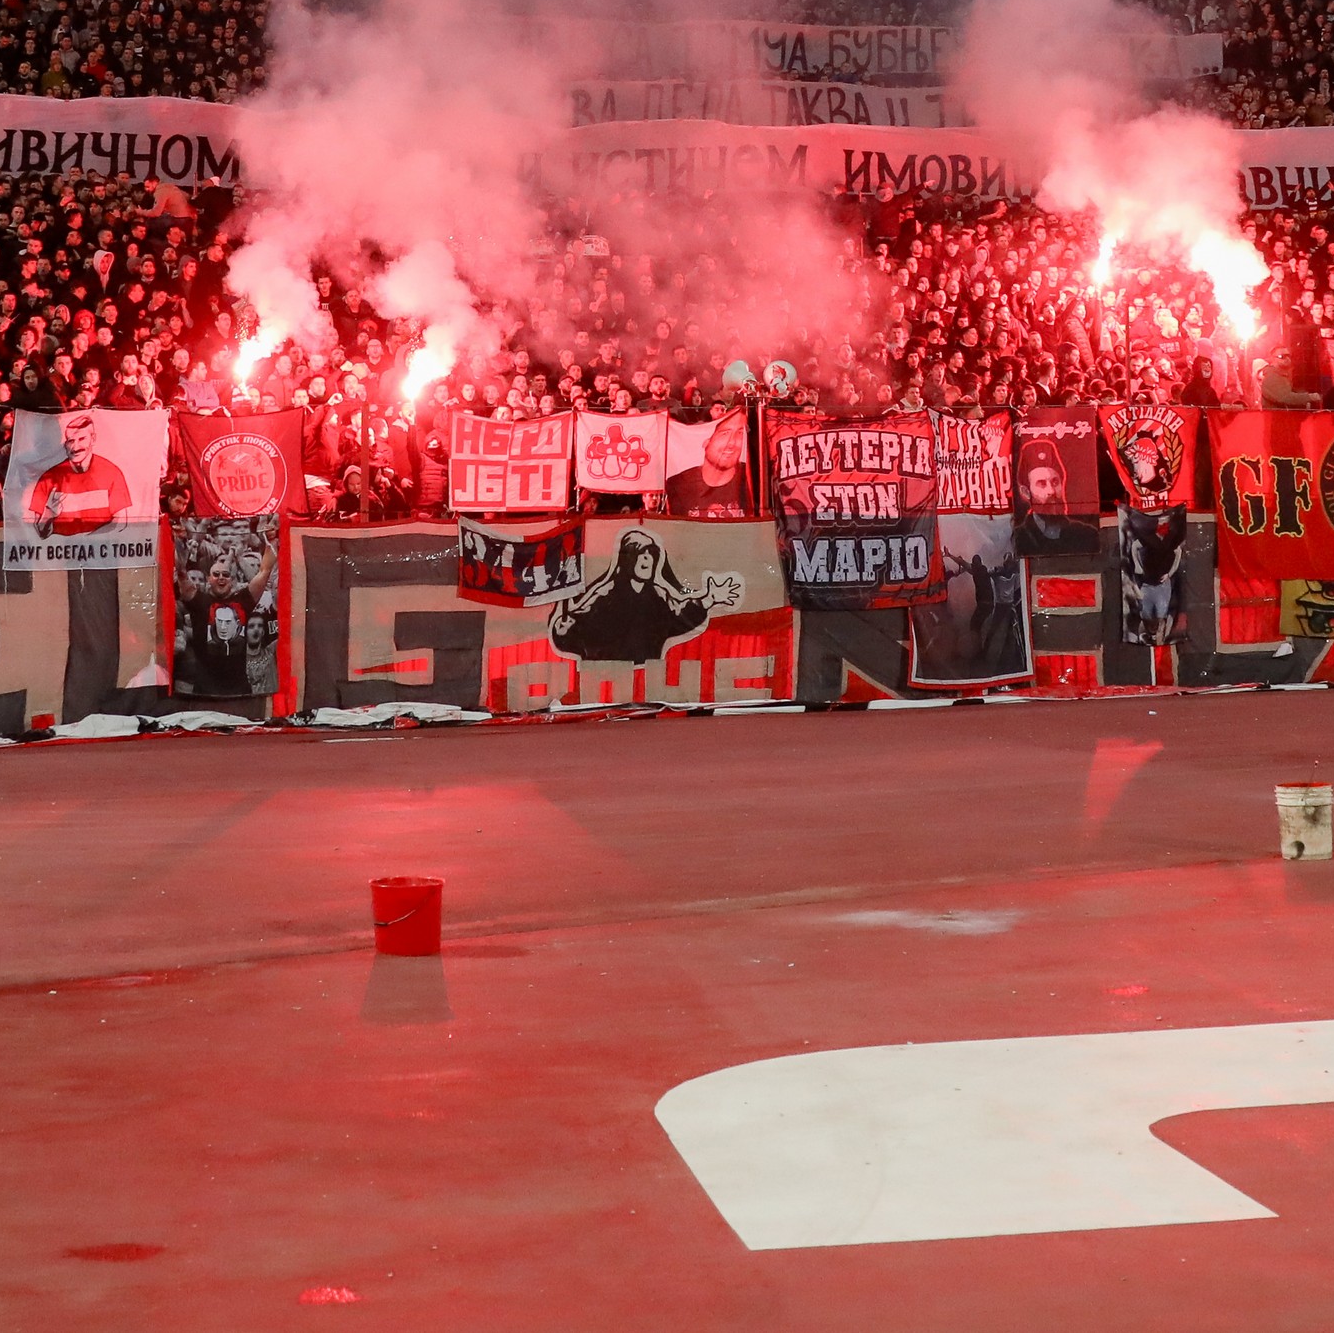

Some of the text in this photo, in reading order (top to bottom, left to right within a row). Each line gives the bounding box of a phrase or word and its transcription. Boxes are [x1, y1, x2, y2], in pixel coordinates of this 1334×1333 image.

[812, 483, 899, 521] ΣΤΟΝ
[1219, 455, 1313, 538] GF
[9, 538, 153, 563] ДРУГ ВСЕГДА С ТОБОЙ
[793, 537, 929, 584] ΜΑΡΙΟ
